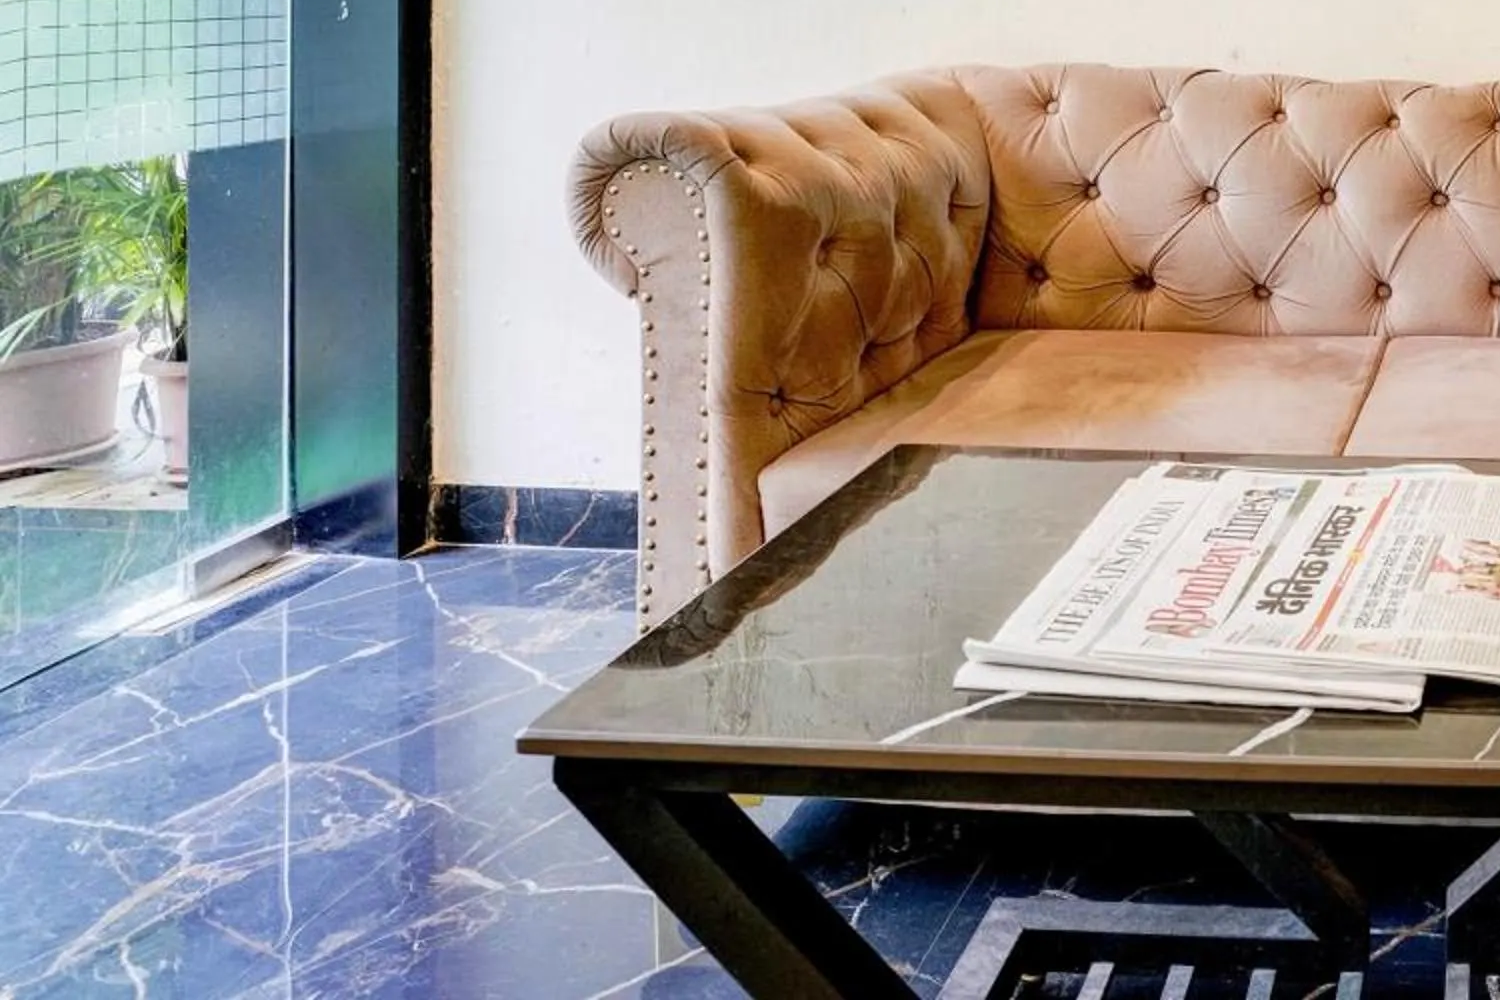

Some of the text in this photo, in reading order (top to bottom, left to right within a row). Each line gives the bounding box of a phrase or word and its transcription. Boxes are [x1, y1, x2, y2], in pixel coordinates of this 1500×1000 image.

[1147, 496, 1279, 632] Bombay Times
[1256, 504, 1364, 615] दैनिक भास्कर
[1036, 606, 1093, 643] THE
